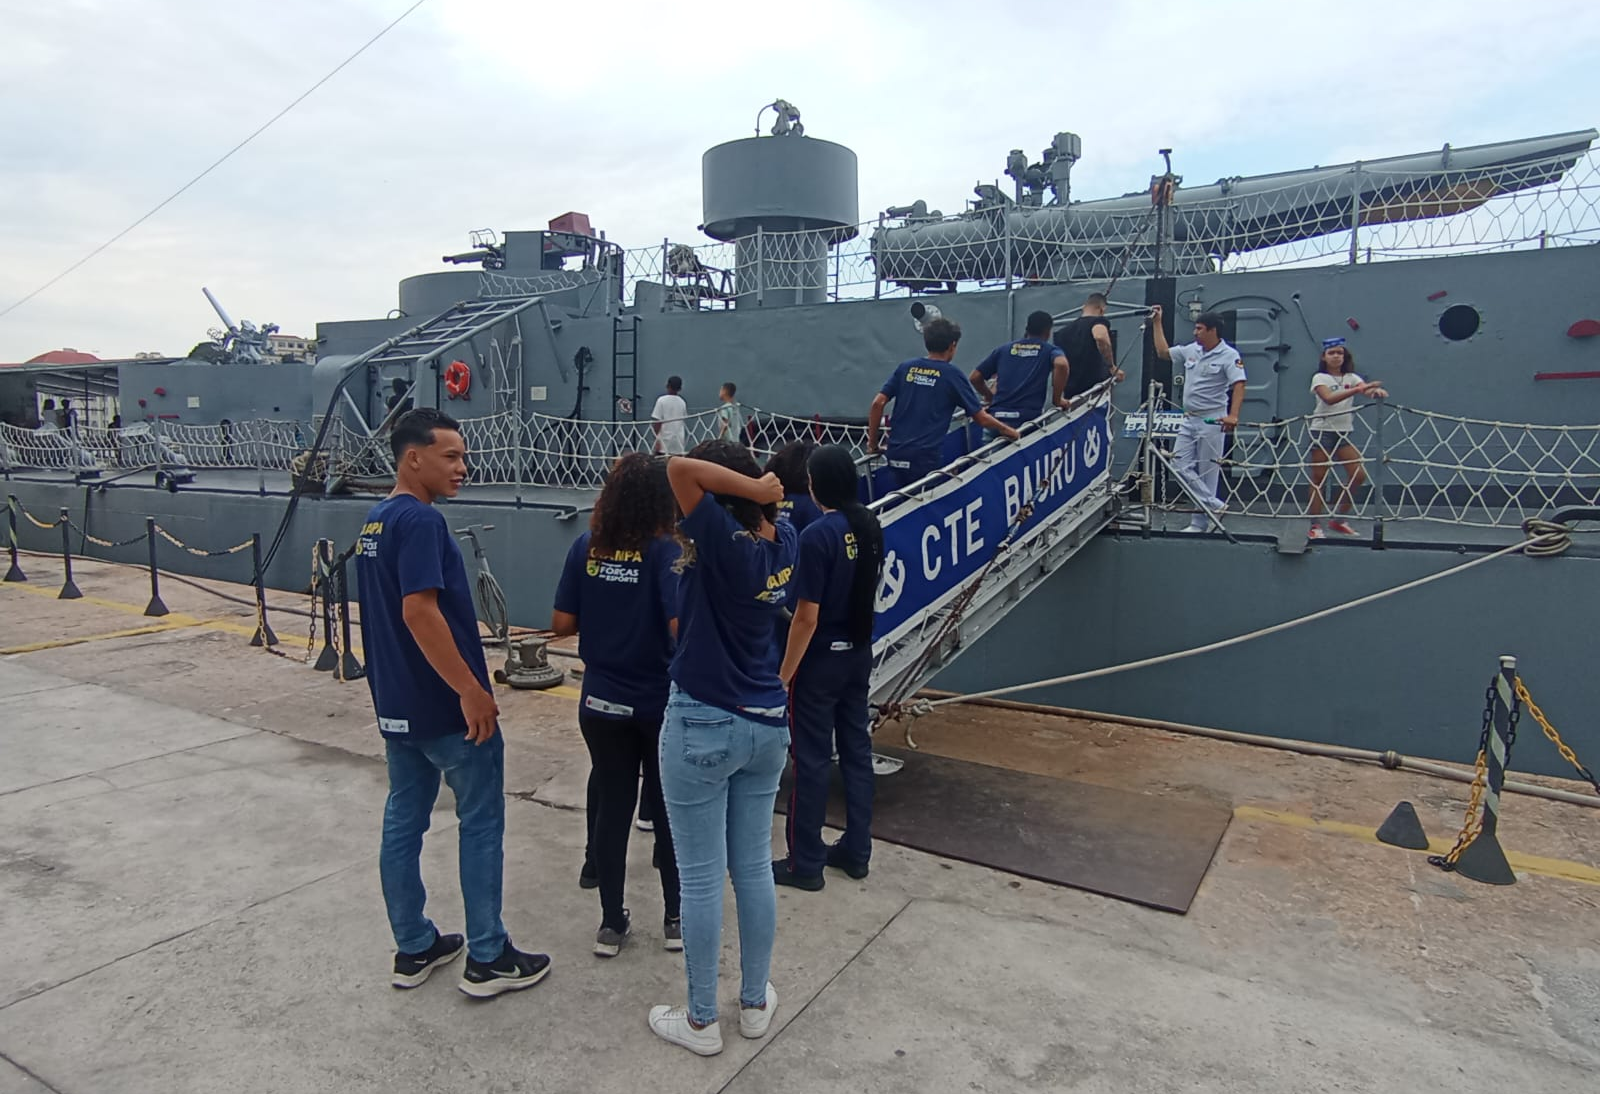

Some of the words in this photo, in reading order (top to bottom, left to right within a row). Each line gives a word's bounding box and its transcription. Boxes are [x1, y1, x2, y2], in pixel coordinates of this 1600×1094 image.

[909, 367, 940, 377] CIAMPA
[921, 496, 985, 581] CTE
[1004, 439, 1076, 528] BAURU
[600, 566, 640, 577] FORÇAS
